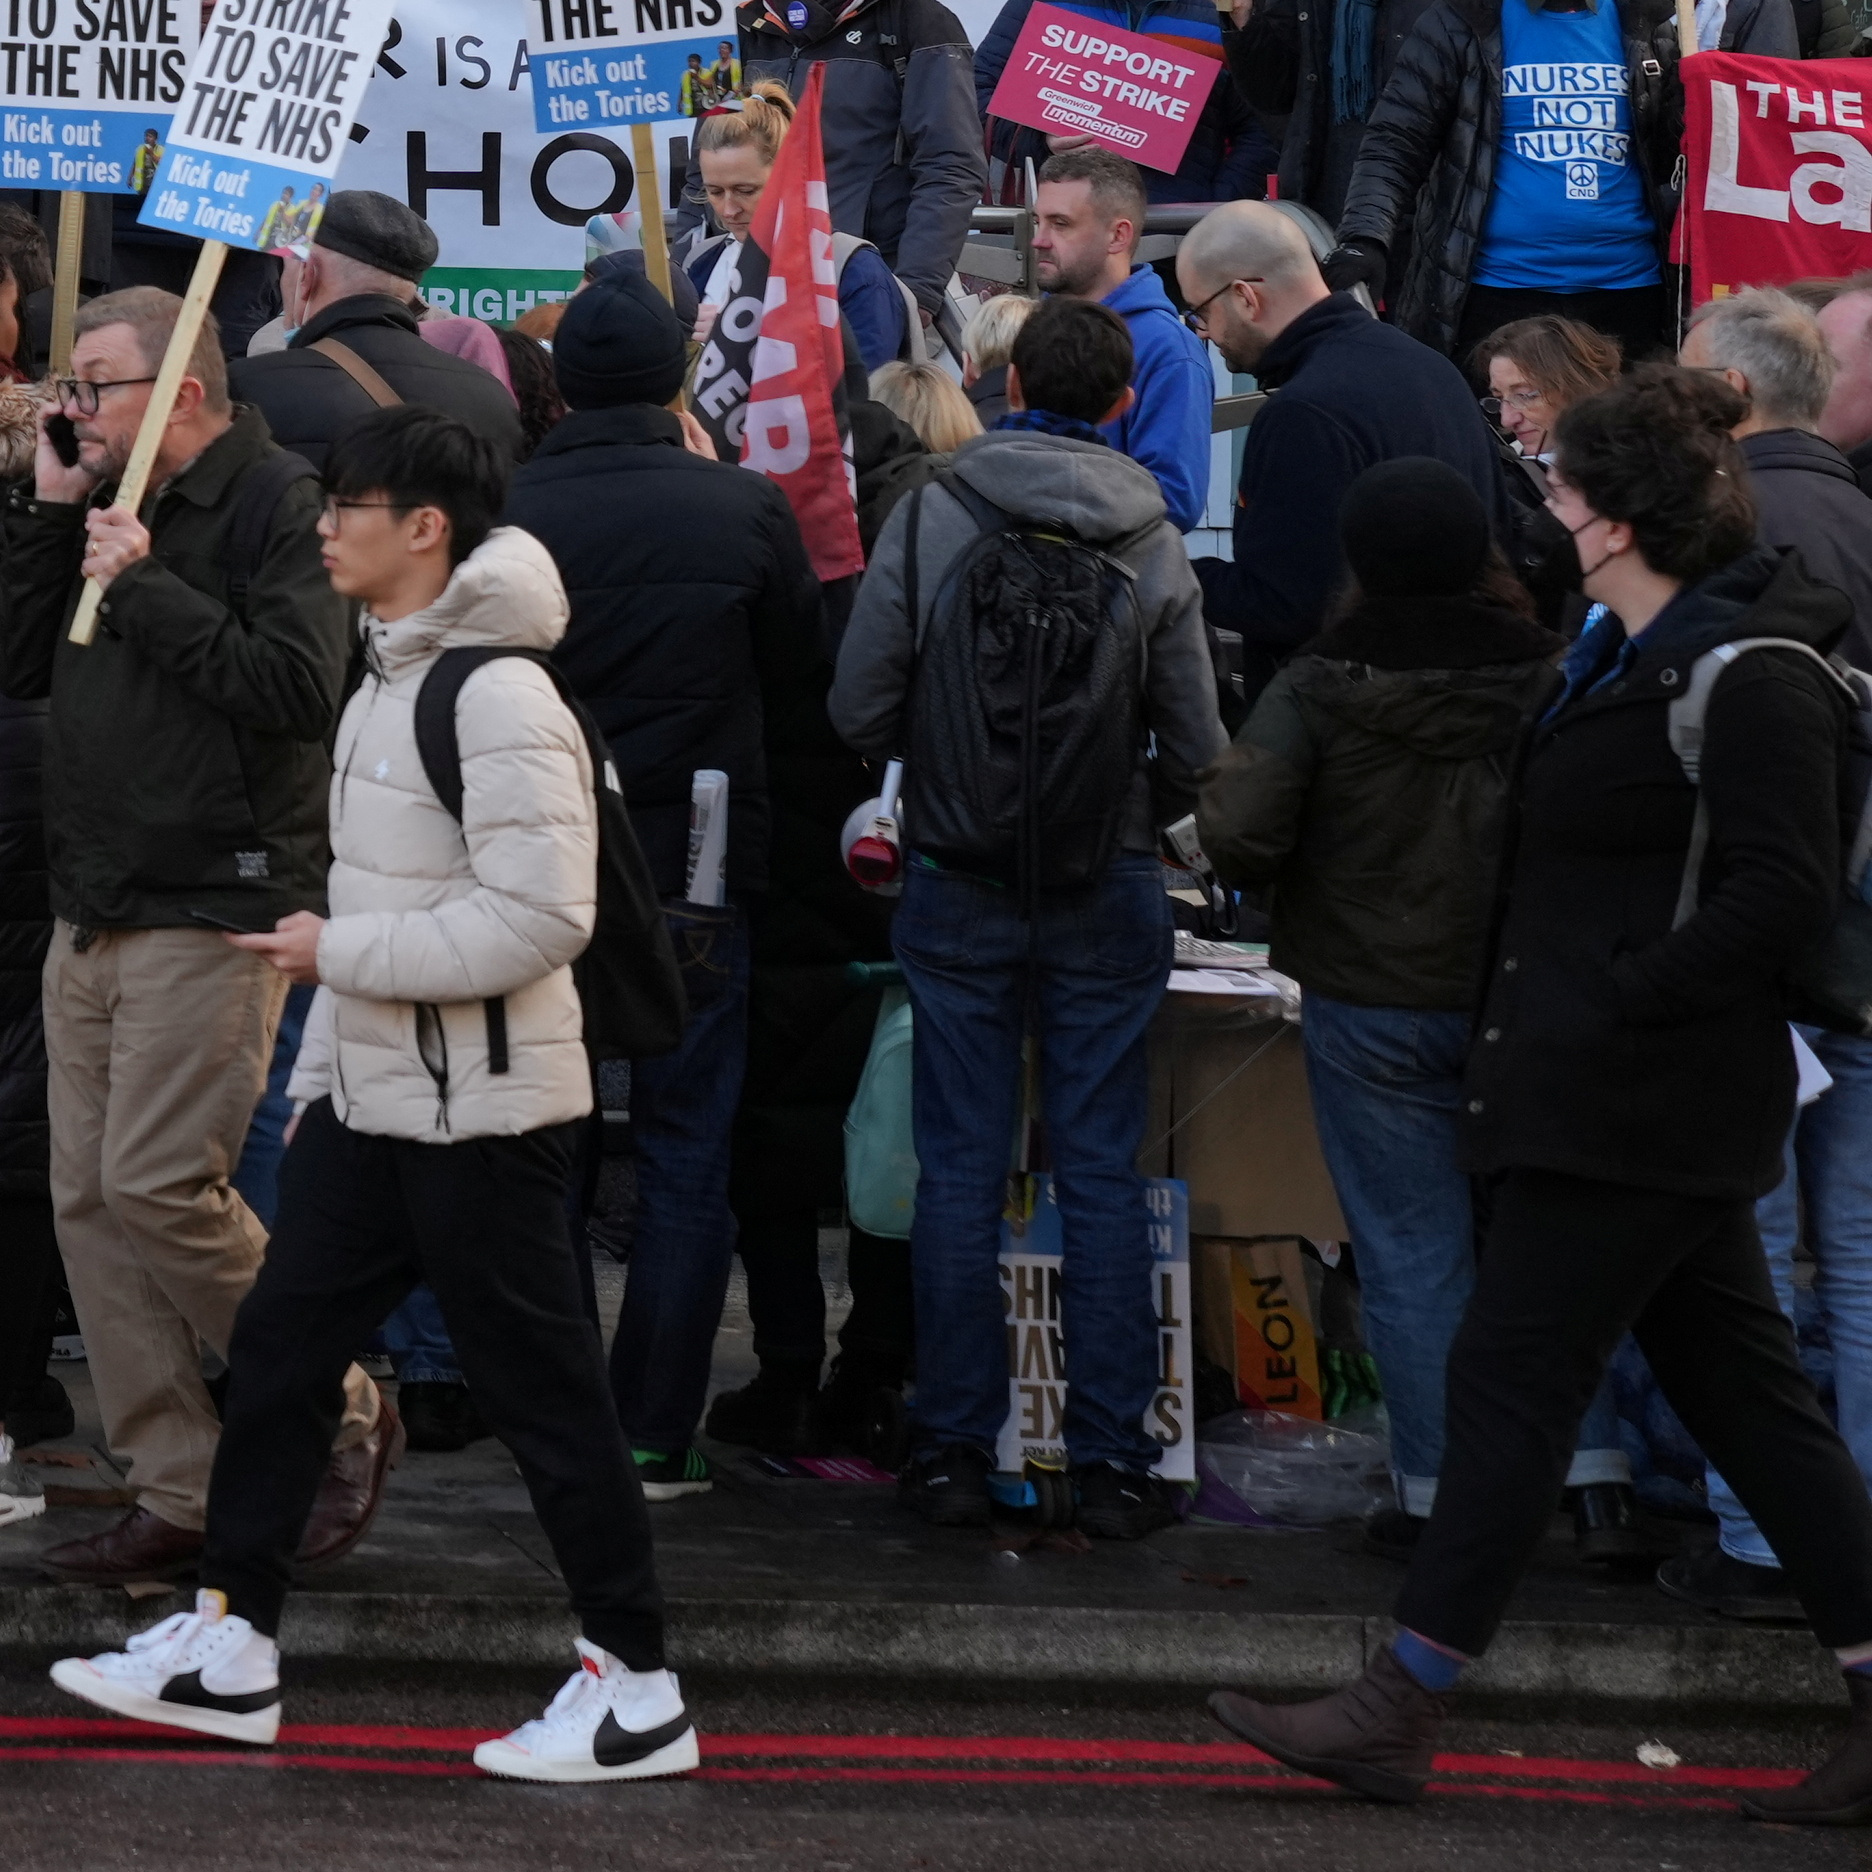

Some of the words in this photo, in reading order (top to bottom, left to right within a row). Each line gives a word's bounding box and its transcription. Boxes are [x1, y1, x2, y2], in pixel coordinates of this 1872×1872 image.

[0, 42, 80, 98] THE
[97, 47, 185, 103] NHS
[206, 25, 256, 84] TO
[258, 37, 359, 105] SAVE
[1041, 24, 1195, 89] SUPPORT
[1505, 65, 1630, 94] NURSES
[1024, 51, 1082, 86] THE
[1079, 70, 1191, 122] STRIKE
[1045, 90, 1095, 112] Greenwich
[1746, 79, 1865, 128] THE
[184, 83, 257, 146] THE
[256, 98, 340, 164] NHS
[1049, 105, 1140, 144] momentum
[1537, 99, 1614, 126] NOT
[1521, 133, 1628, 161] NUKES
[1569, 188, 1595, 198] CND
[1249, 1275, 1298, 1404] LEON
